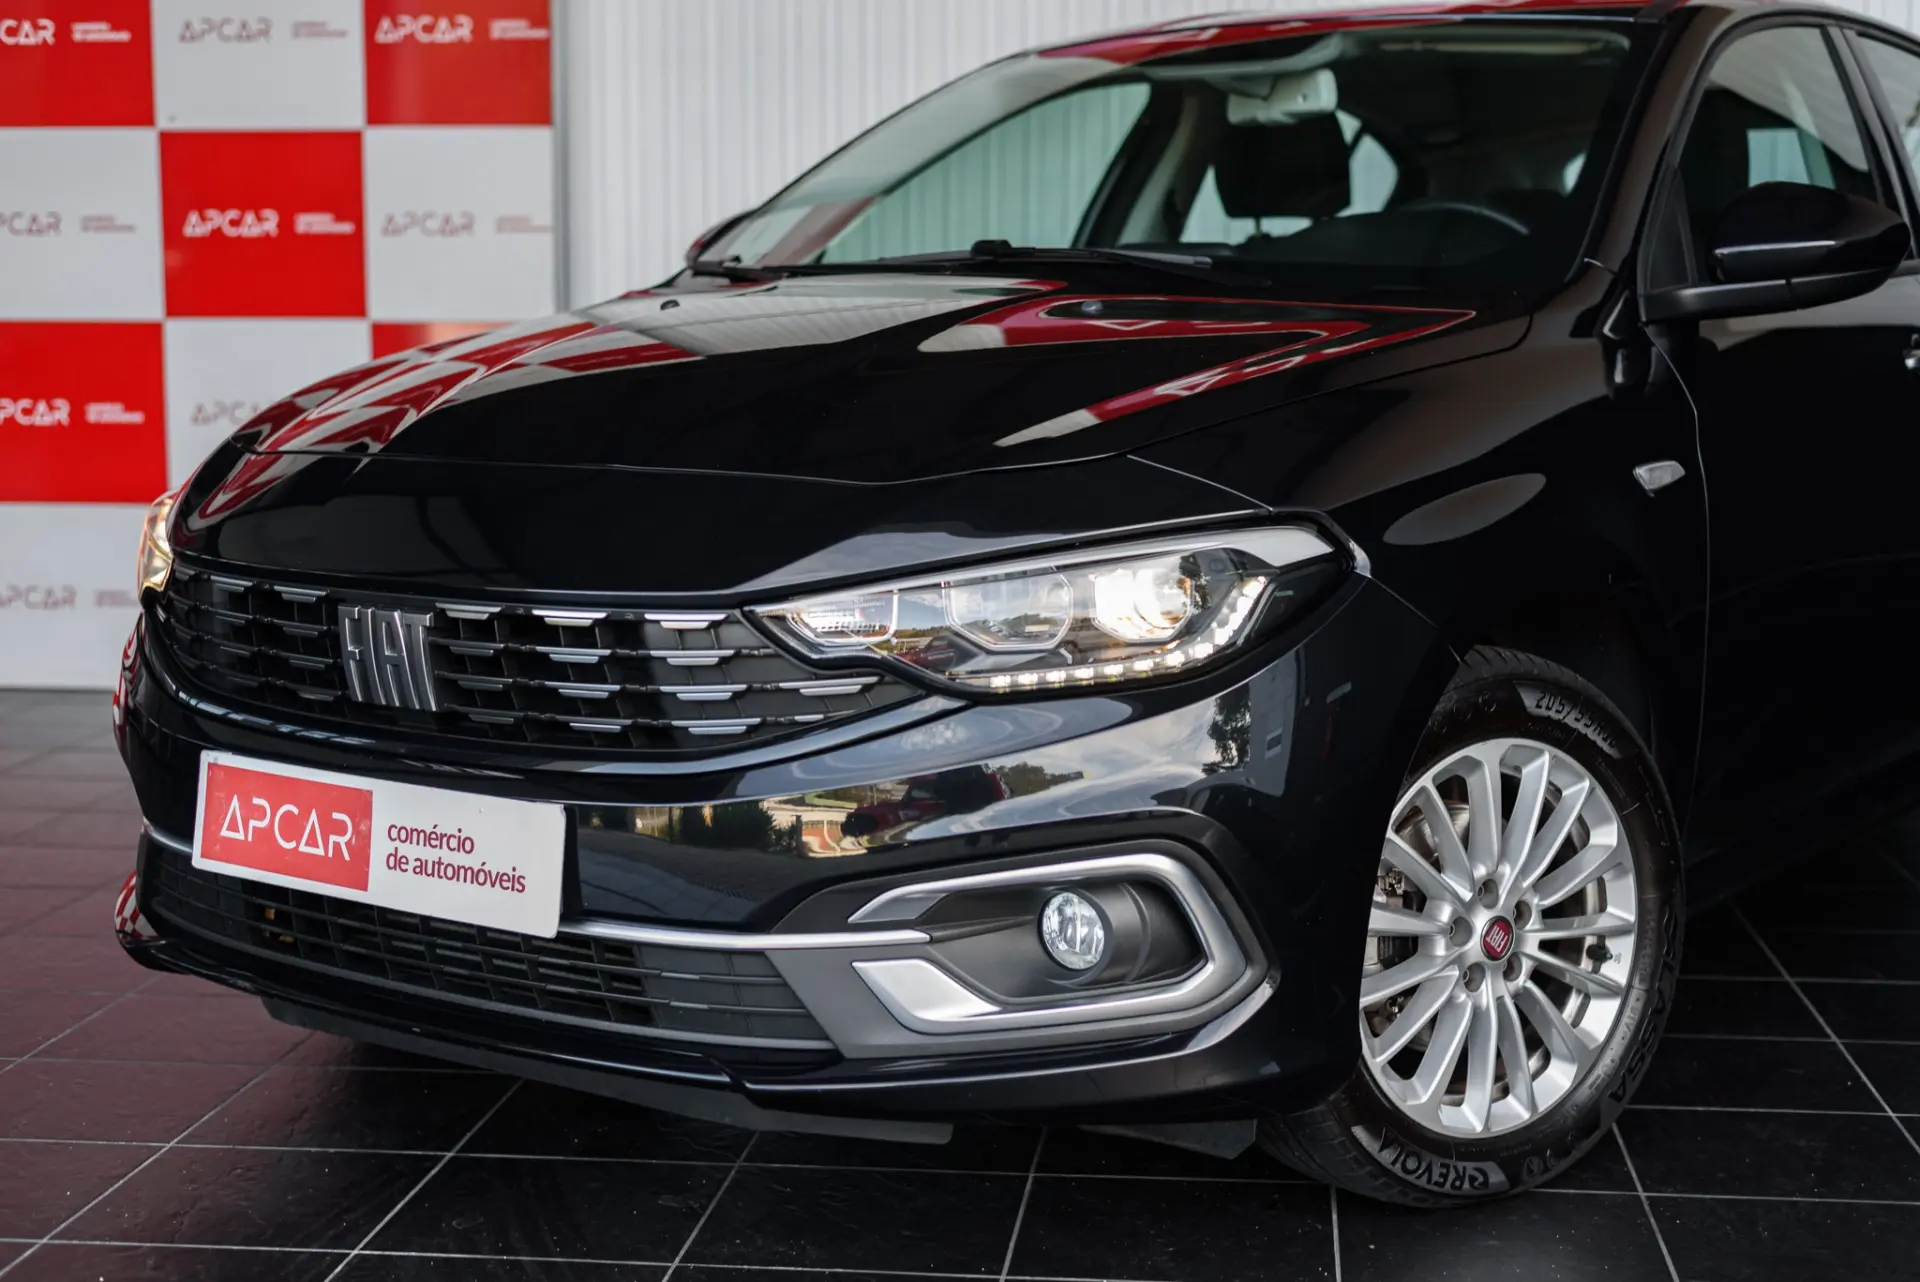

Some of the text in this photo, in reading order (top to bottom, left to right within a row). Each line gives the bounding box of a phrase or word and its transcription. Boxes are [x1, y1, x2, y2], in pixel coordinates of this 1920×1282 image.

[179, 16, 274, 43] APCAR
[375, 14, 473, 43] APCAR
[183, 208, 279, 237] APCAR
[381, 210, 475, 237] APCAR
[0, 584, 77, 610] PCAR
[338, 605, 438, 711] FIAT
[220, 794, 353, 861] APCAR
[387, 823, 475, 854] comércio
[386, 847, 526, 893] de automóveis
